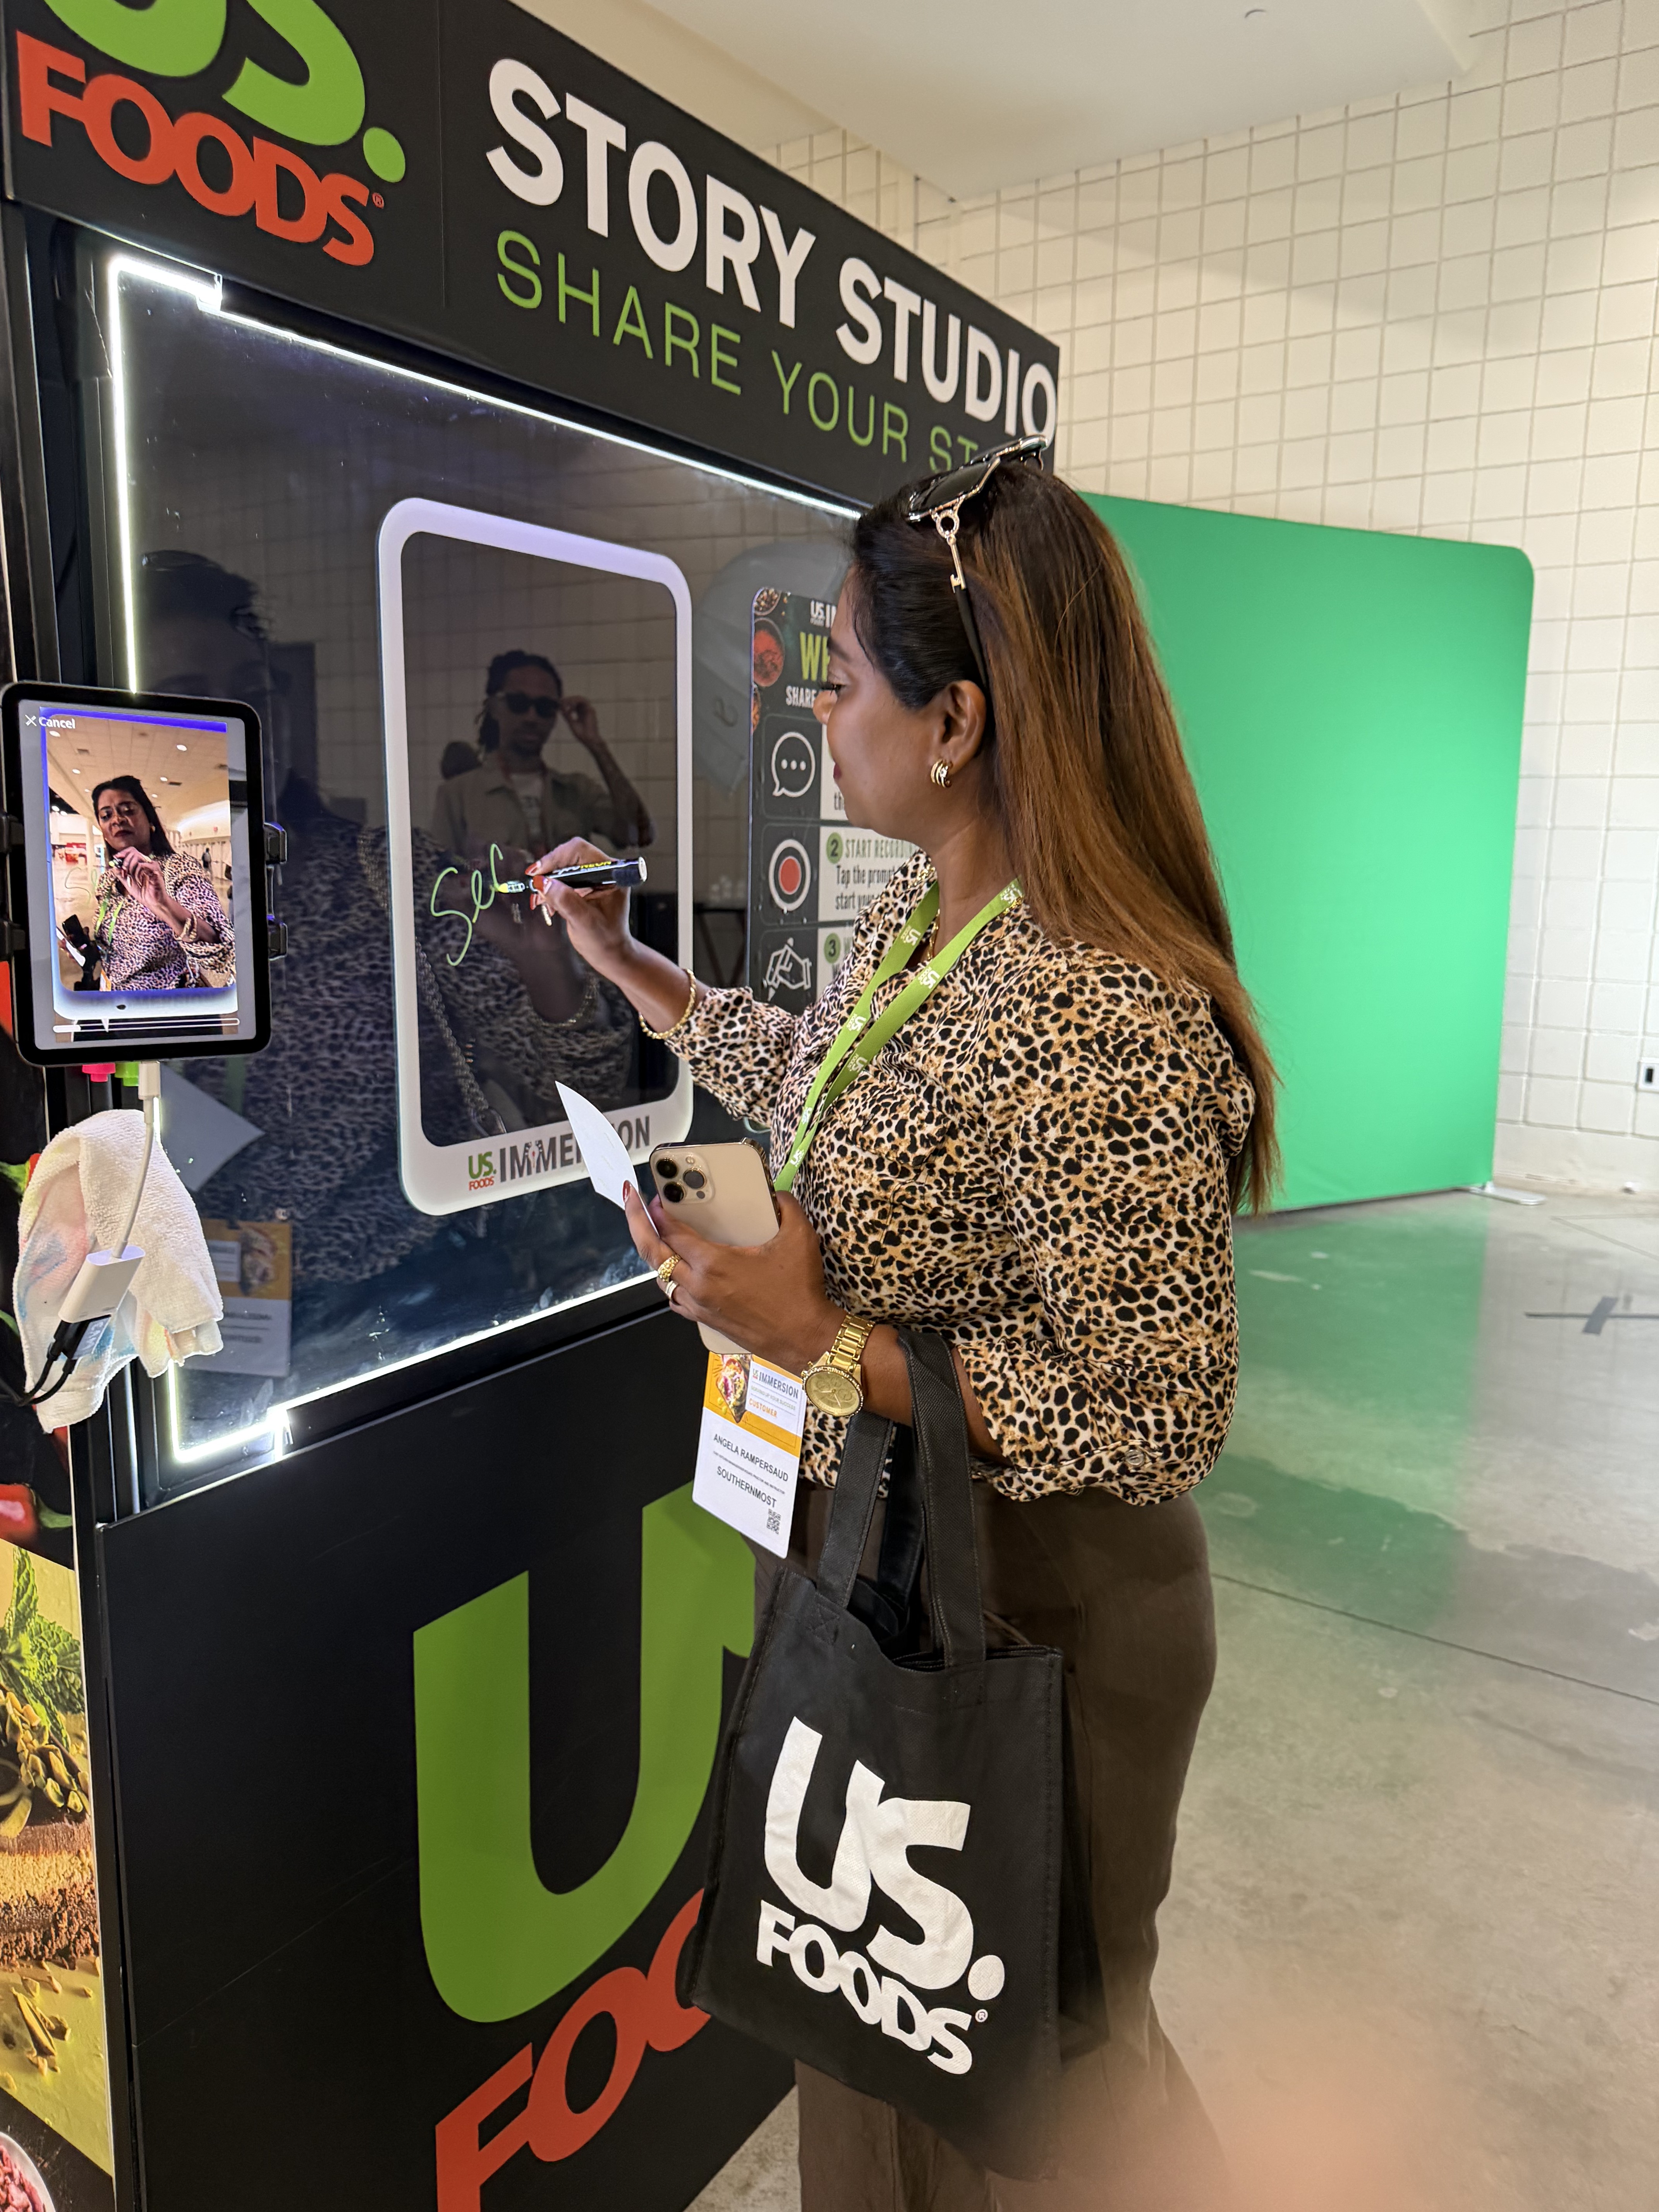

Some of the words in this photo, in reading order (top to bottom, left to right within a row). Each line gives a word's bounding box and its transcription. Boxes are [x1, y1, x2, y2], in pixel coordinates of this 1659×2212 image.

[486, 58, 816, 329] STORY
[835, 257, 1058, 448] STUDIO
[496, 230, 741, 395] SHARE
[772, 350, 908, 463] YOUR
[39, 716, 76, 729] Cancel
[830, 839, 838, 857] 2
[845, 838, 871, 859] START
[836, 865, 851, 888] Tap
[853, 865, 866, 884] the
[836, 892, 855, 910] start
[829, 939, 836, 957] 3
[499, 1115, 650, 1183] IMMEON
[468, 1176, 495, 1191] FOODS
[759, 1372, 799, 1399] IMMERSION
[749, 1398, 777, 1418] CUSTOMER
[714, 1434, 739, 1455] ANGELA
[740, 1449, 788, 1482] RAMPERSAUD
[717, 1465, 777, 1508] SOUTHERNMOST
